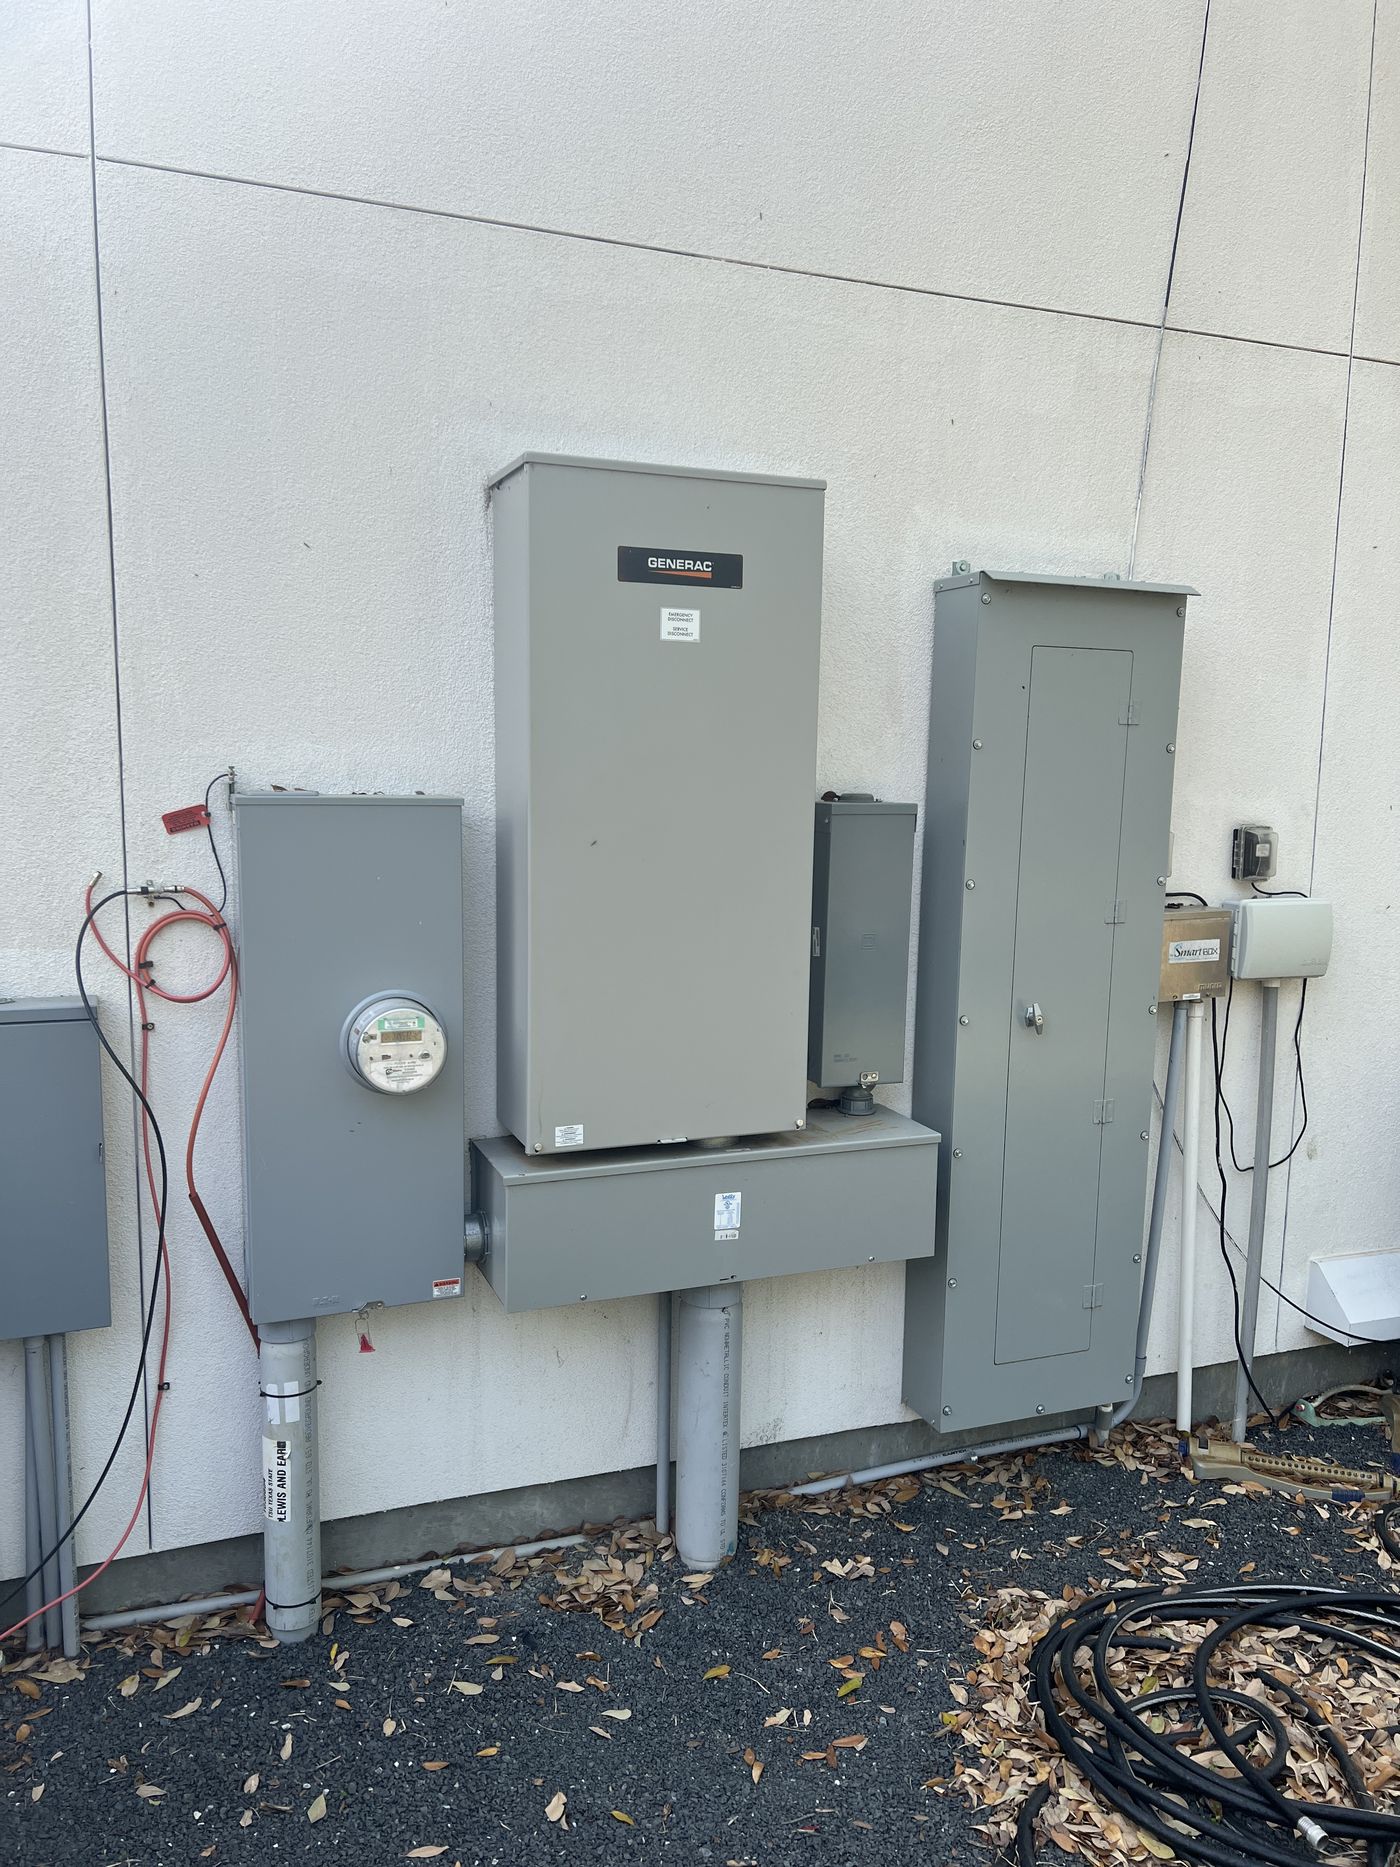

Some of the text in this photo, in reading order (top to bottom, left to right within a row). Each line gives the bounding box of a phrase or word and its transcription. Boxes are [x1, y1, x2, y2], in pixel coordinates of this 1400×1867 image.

[648, 557, 712, 571] GENERAC
[277, 1470, 286, 1489] AND
[277, 1492, 286, 1520] LEWIS
